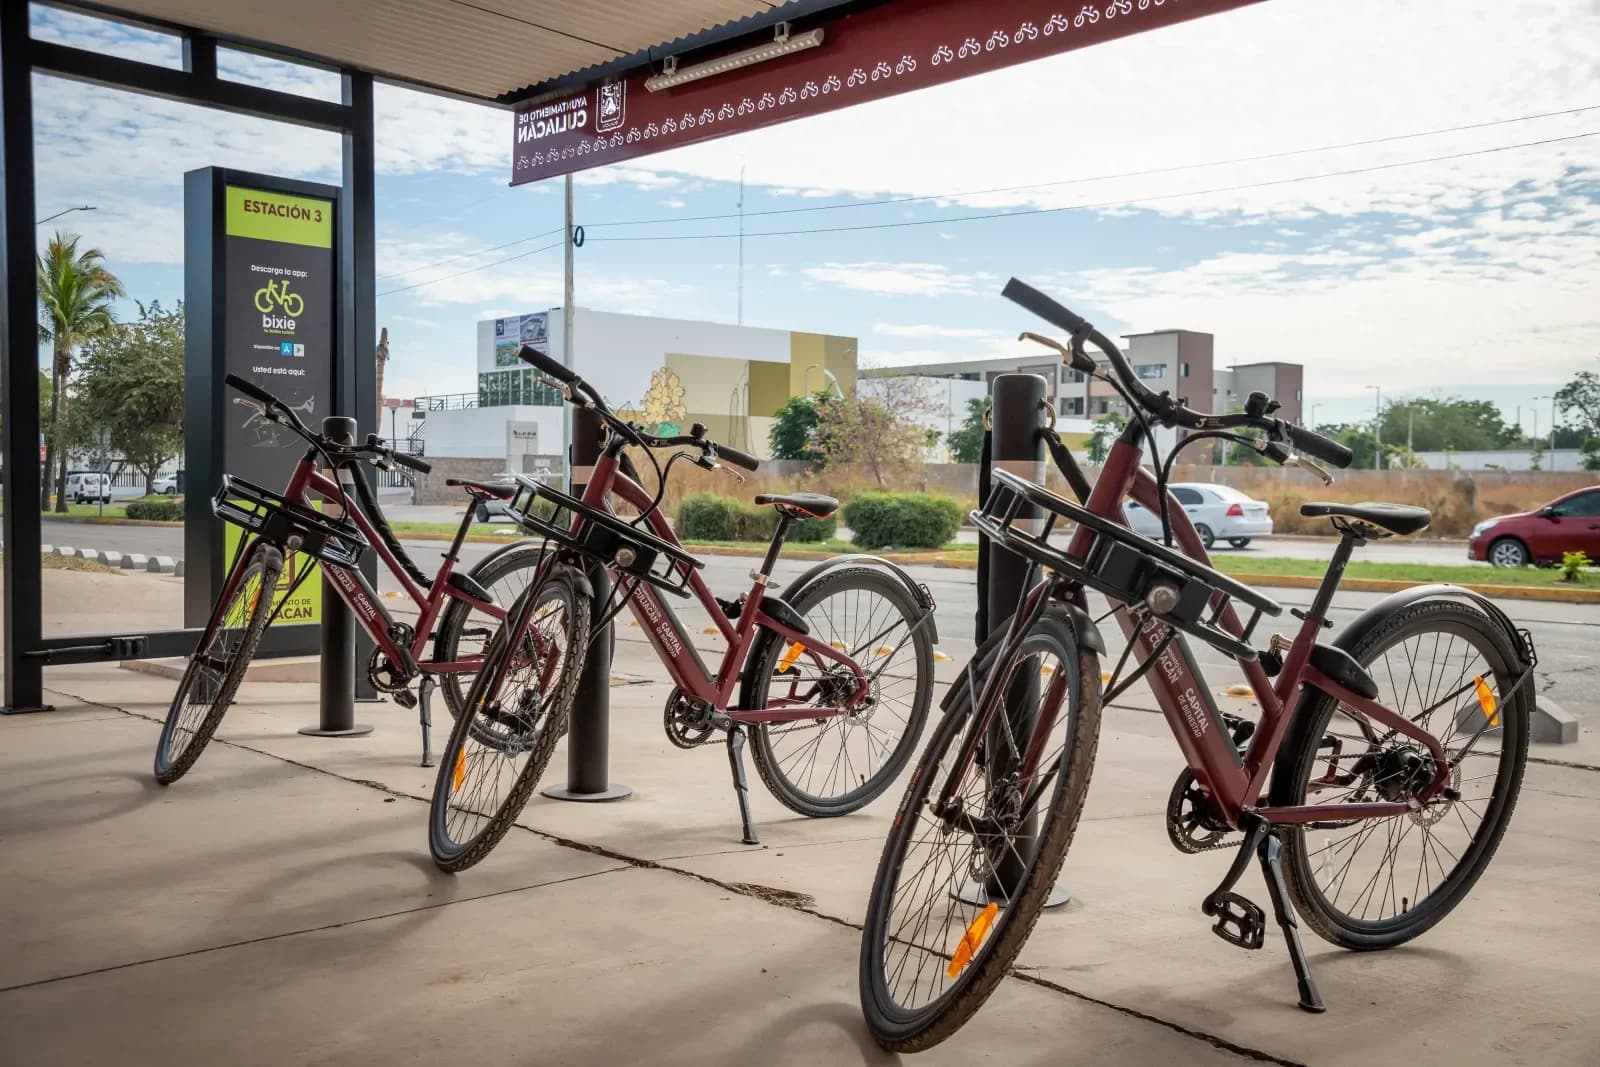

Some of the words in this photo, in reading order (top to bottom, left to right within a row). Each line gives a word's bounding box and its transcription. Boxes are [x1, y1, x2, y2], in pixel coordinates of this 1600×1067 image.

[244, 199, 311, 221] ESTACIÓN
[314, 210, 322, 222] 3
[251, 264, 284, 275] Descarga
[284, 267, 291, 275] la
[292, 270, 308, 278] app:
[262, 313, 296, 330] bixie
[252, 366, 272, 375] Usted
[357, 593, 377, 620] CAPITAL
[661, 622, 682, 655] CAPITAL
[1177, 694, 1187, 705] DE
[1182, 704, 1202, 738] BIENESTAR
[1185, 687, 1209, 734] CAPITAL
